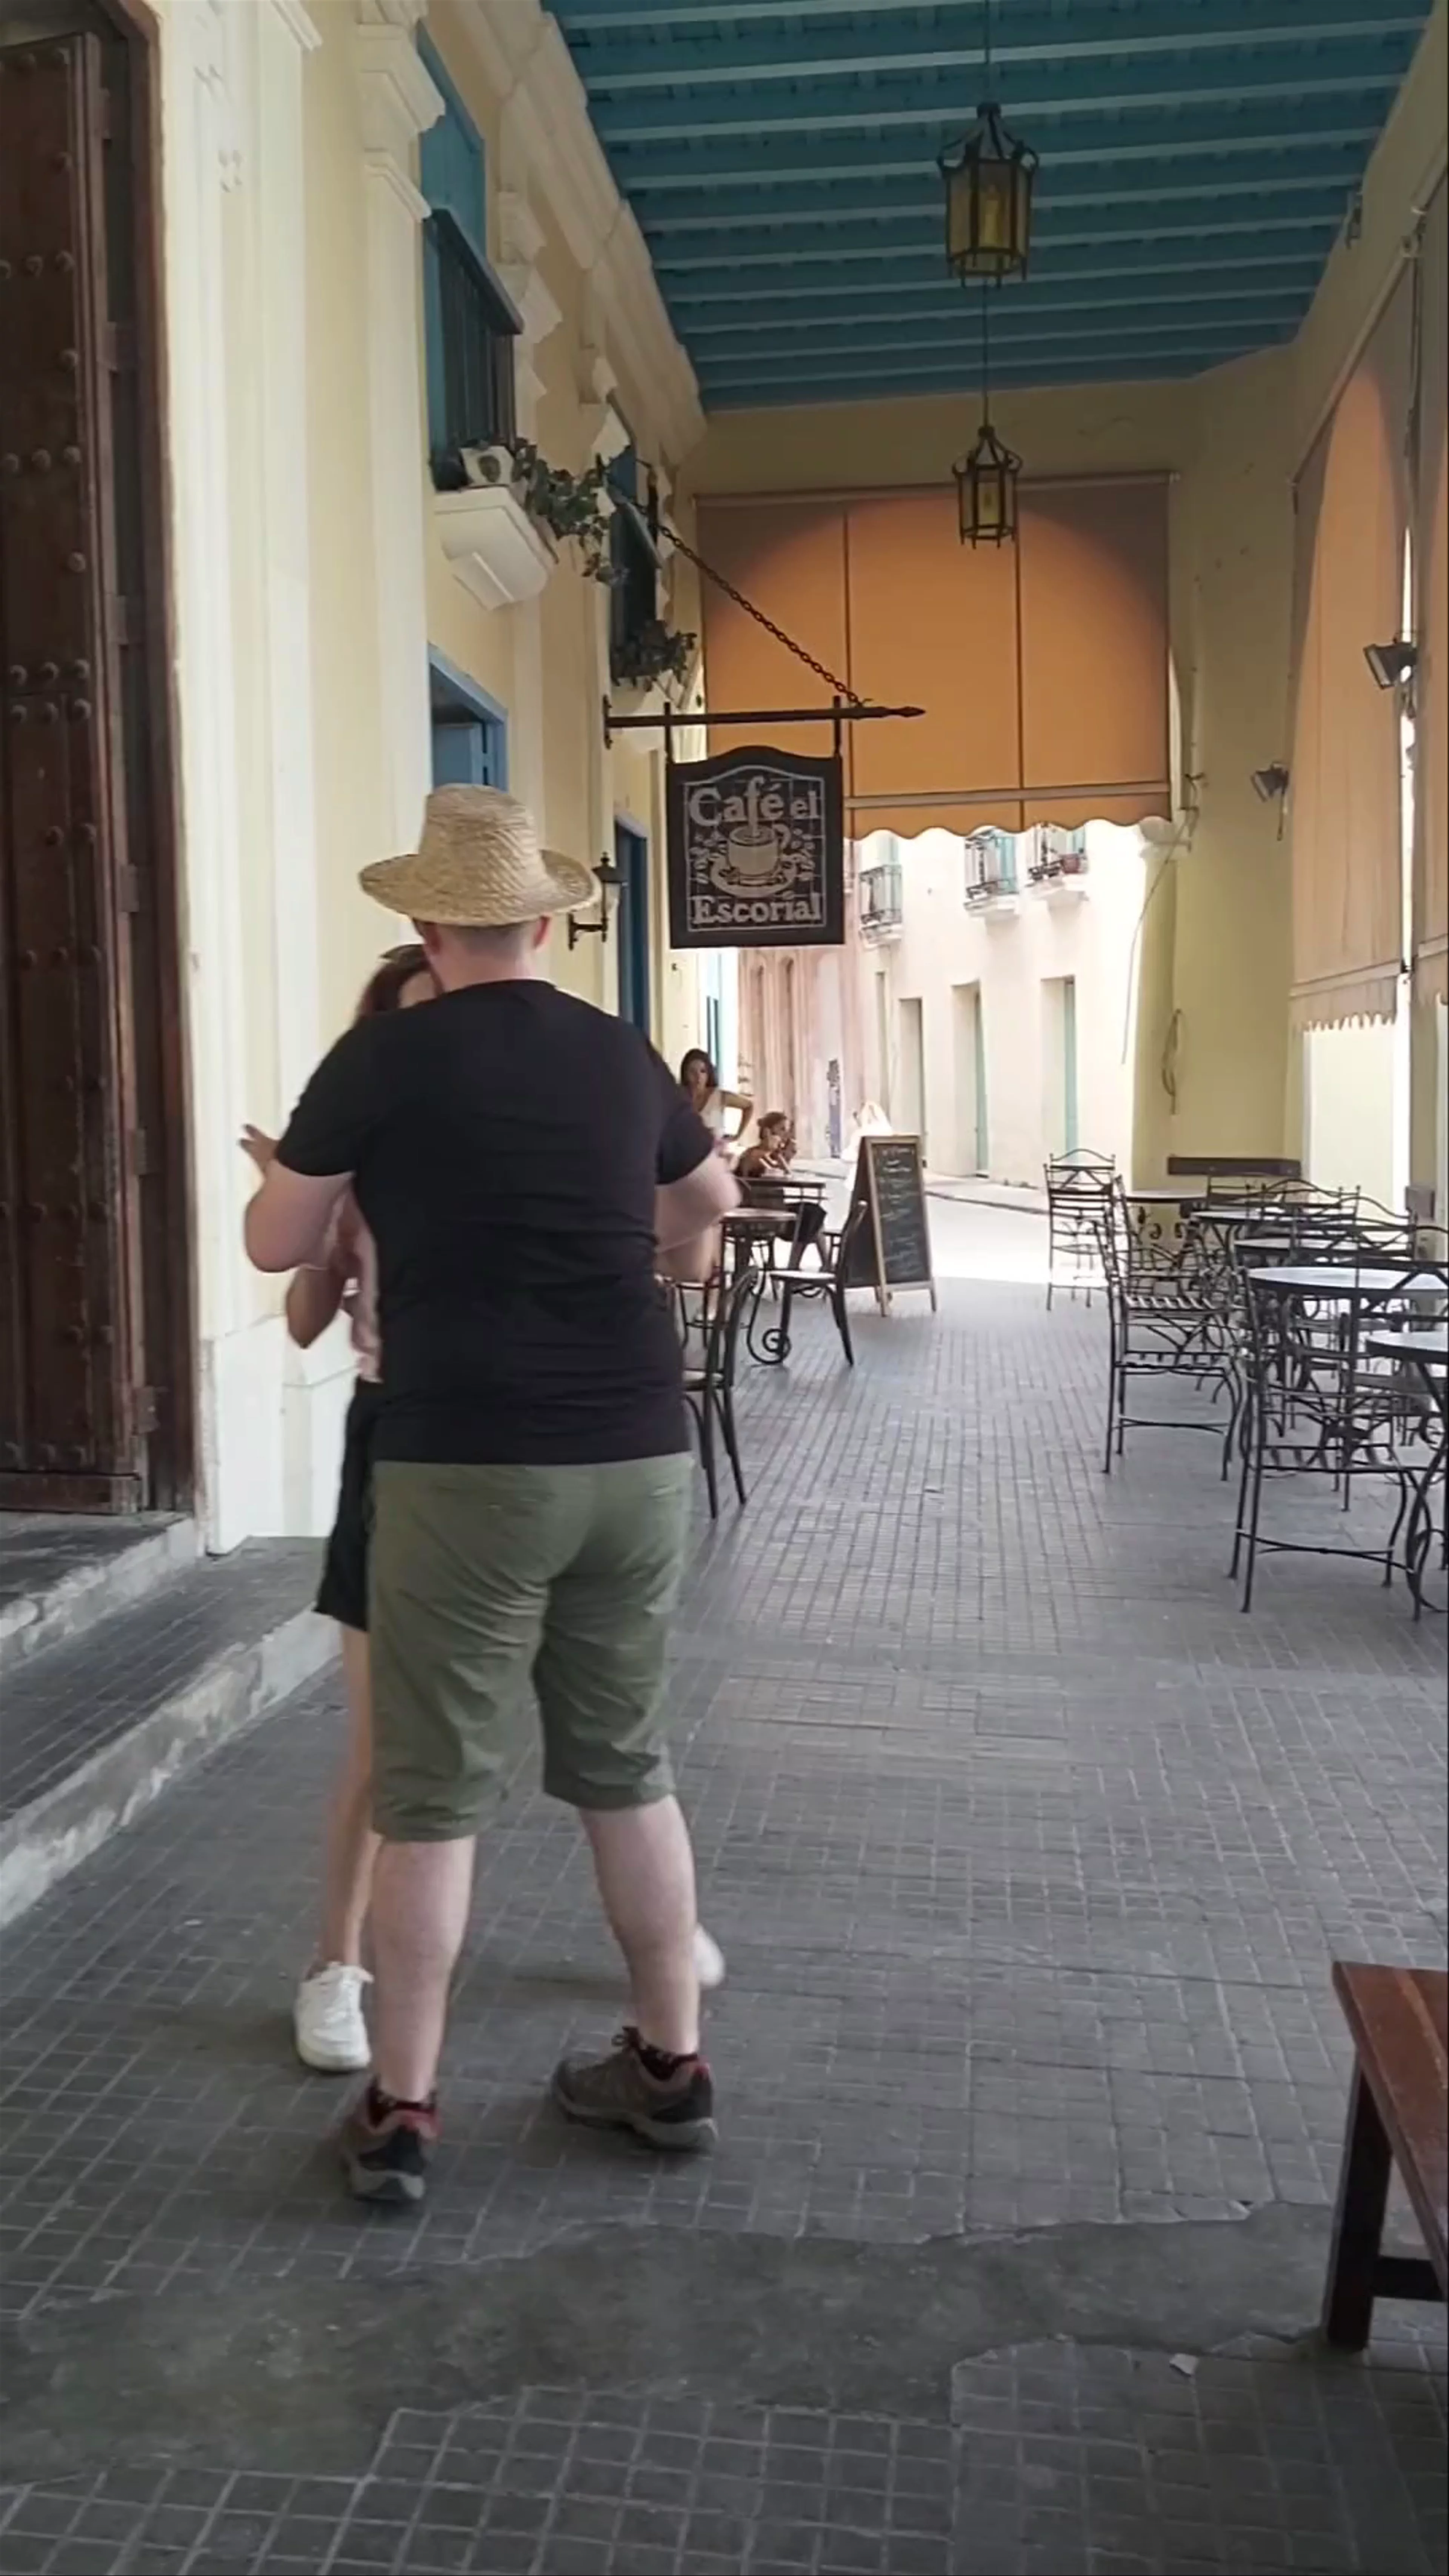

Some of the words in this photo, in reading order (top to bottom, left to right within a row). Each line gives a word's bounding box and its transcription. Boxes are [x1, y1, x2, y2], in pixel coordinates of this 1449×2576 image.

[689, 776, 784, 826] Café
[790, 790, 820, 820] el
[692, 892, 821, 924] Escorial
